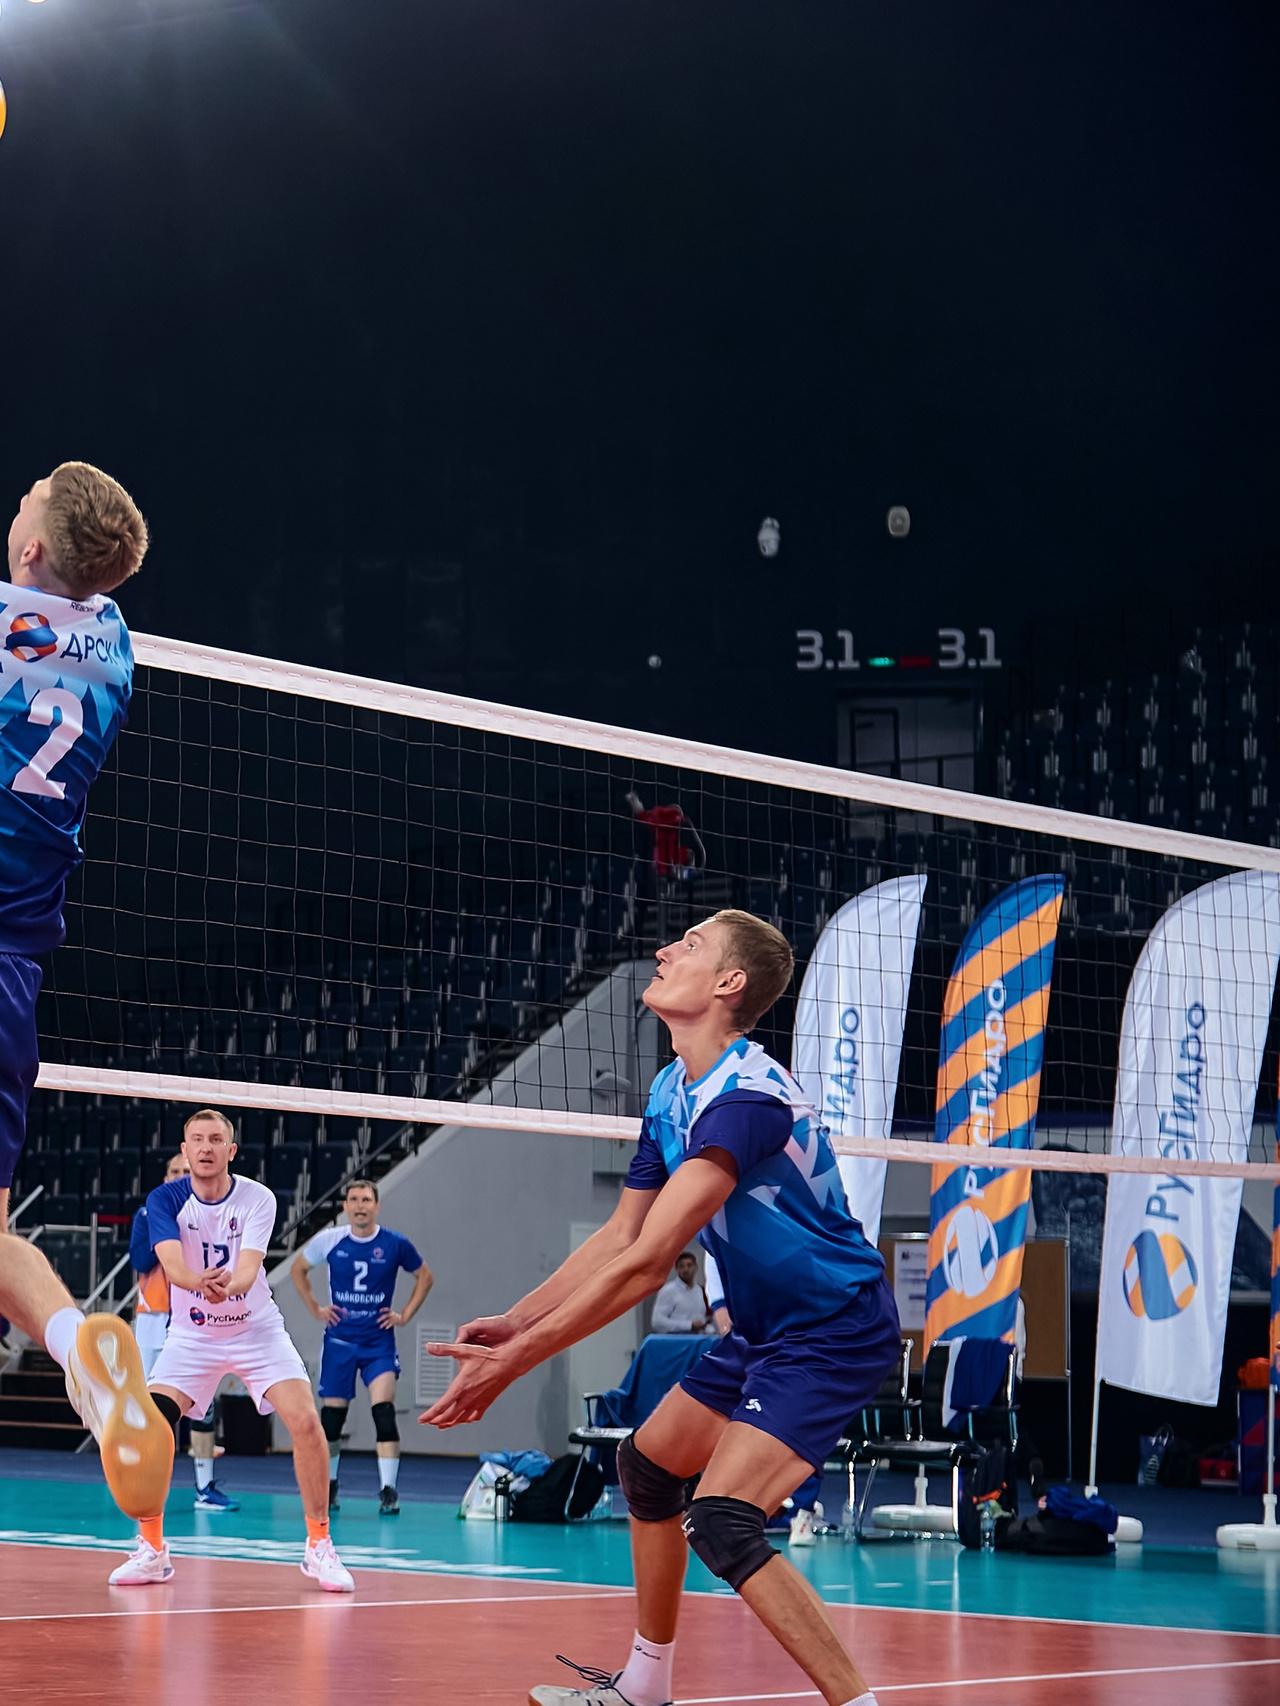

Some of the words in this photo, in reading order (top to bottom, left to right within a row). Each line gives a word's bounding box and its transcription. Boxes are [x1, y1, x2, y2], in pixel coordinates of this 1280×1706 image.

[60, 632, 118, 665] ДРСК
[796, 628, 860, 670] 3.1
[938, 627, 1002, 669] 3.1
[11, 687, 84, 801] 2
[823, 1006, 860, 1134] идро
[963, 978, 1007, 1199] РсГидро
[202, 1242, 230, 1270] 12
[353, 1260, 369, 1292] 2
[206, 1309, 252, 1323] РусГидро
